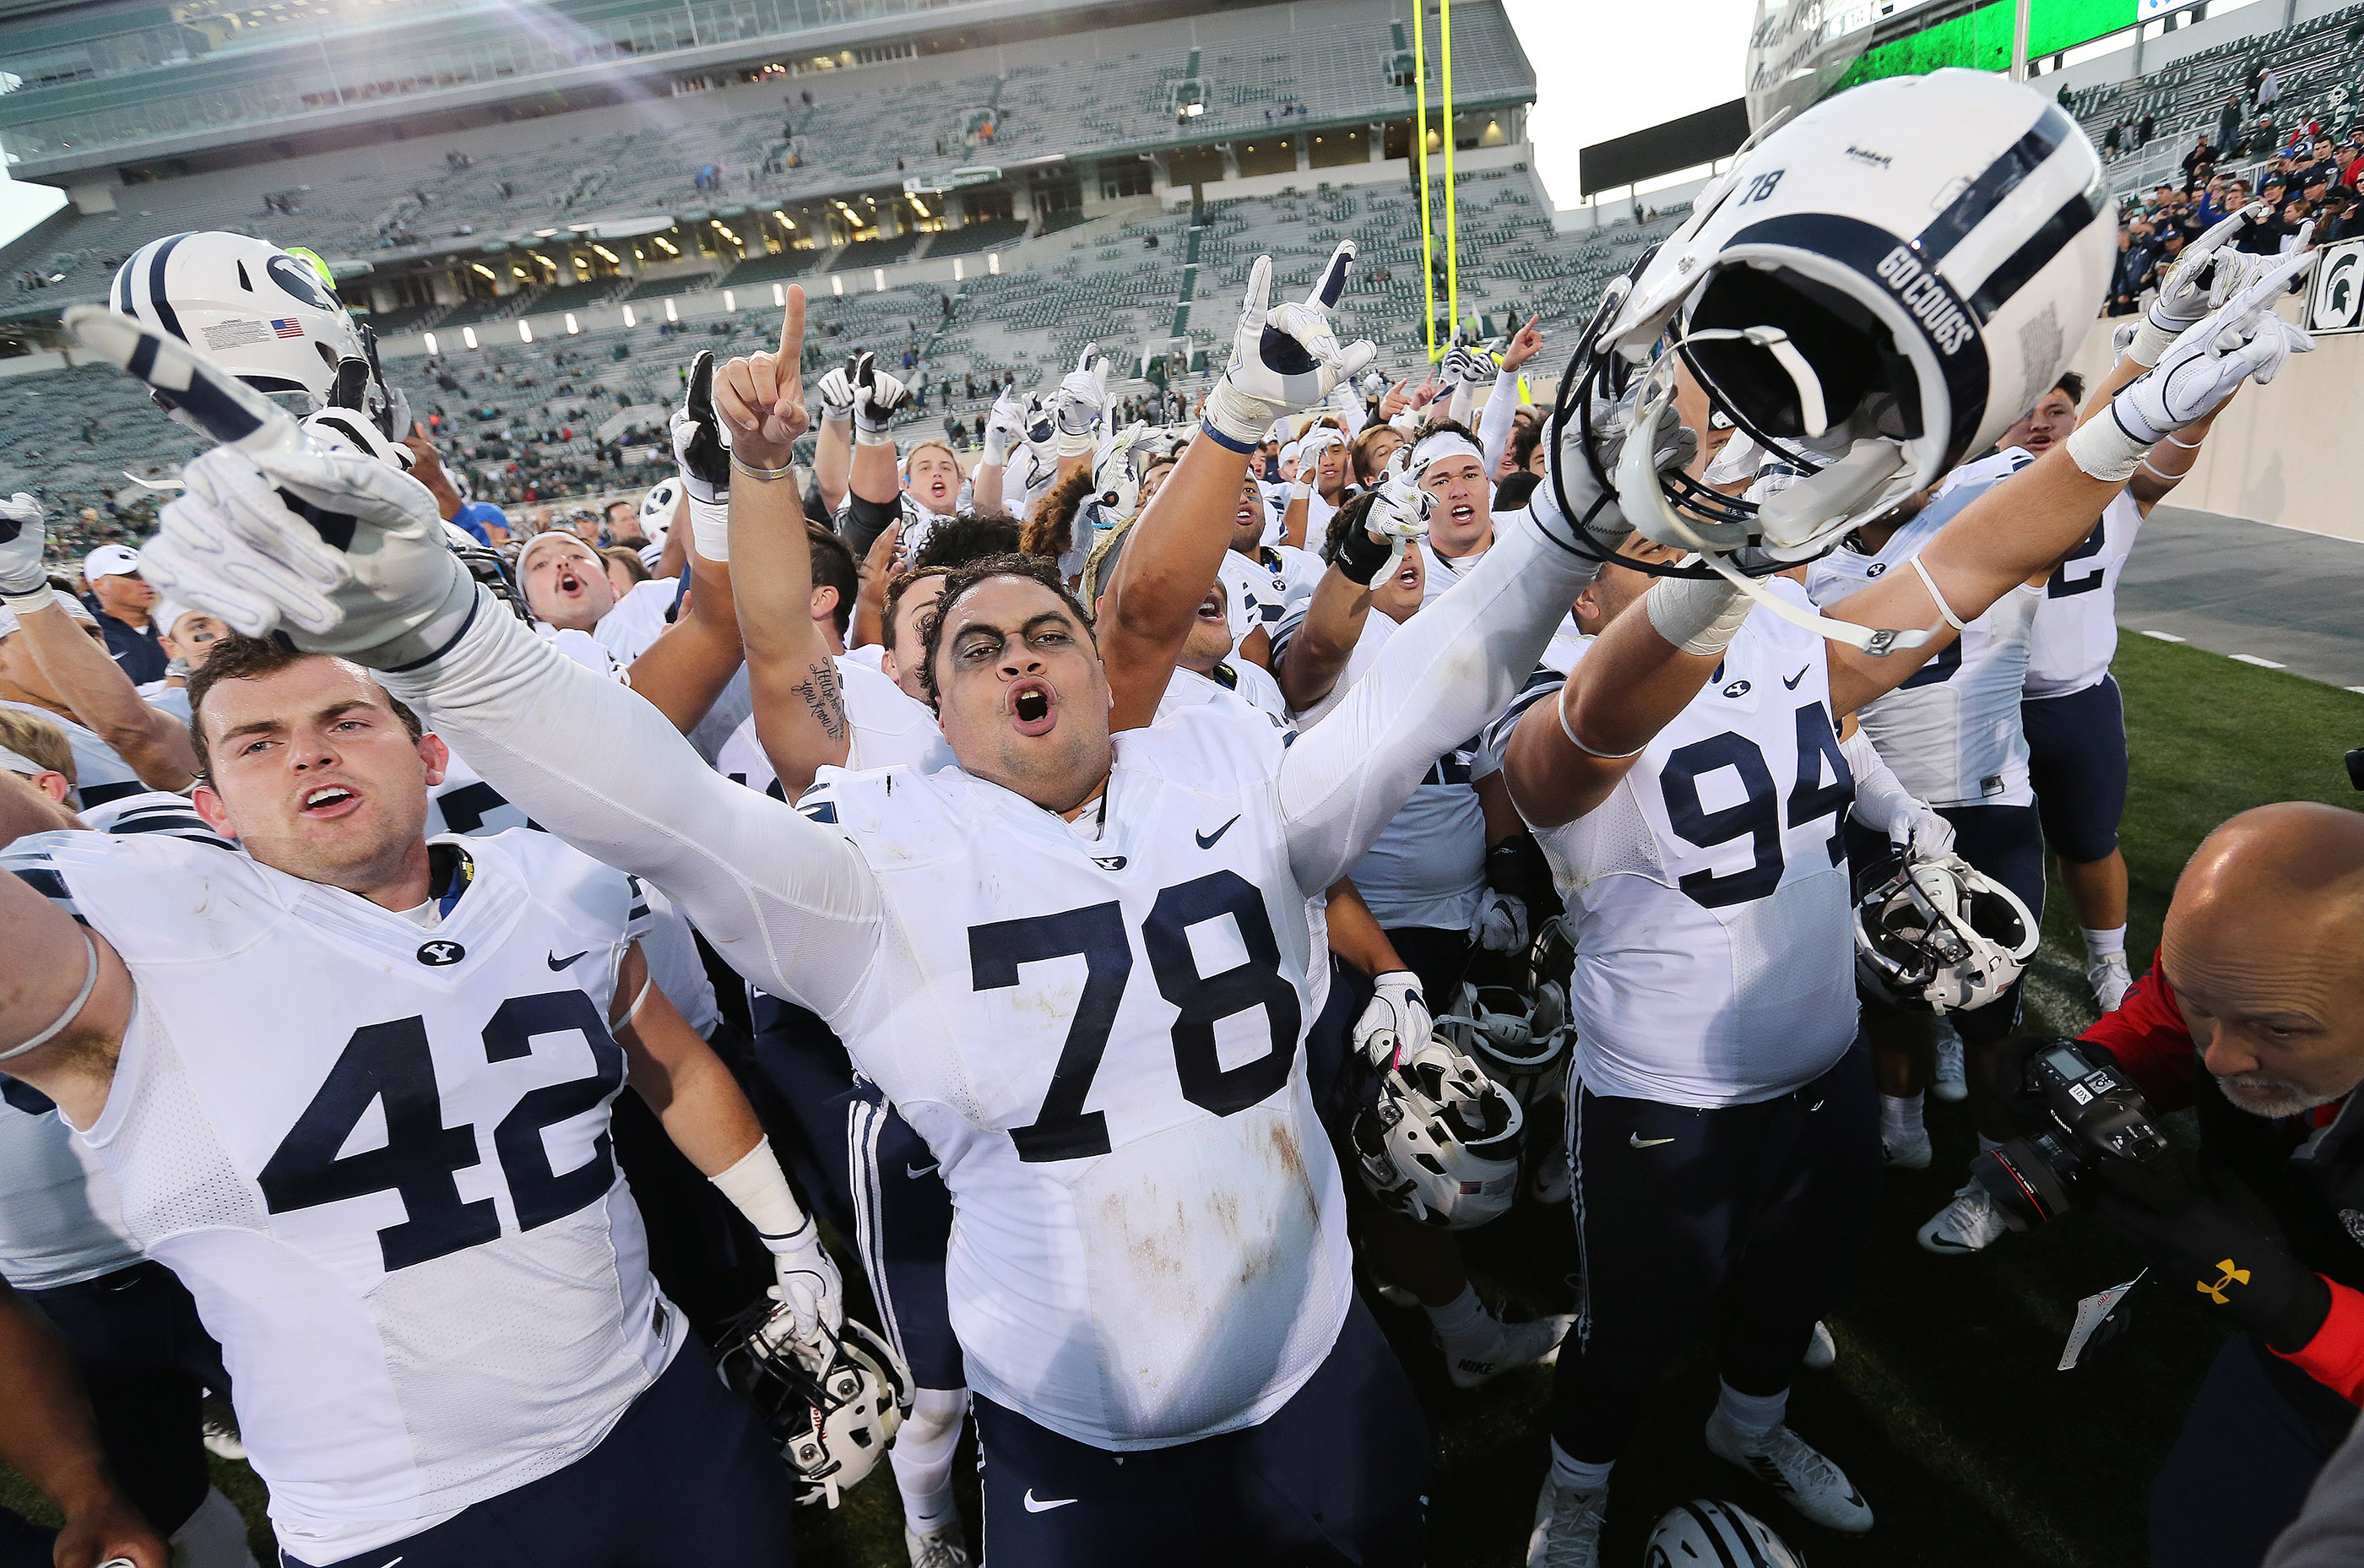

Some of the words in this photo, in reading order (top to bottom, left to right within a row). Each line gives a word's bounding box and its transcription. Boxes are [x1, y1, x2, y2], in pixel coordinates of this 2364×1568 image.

[1738, 168, 1787, 208] 78
[1876, 245, 1922, 290] GO
[1901, 272, 1975, 356] COUGS
[1659, 701, 1857, 909] 94
[967, 869, 1303, 1164] 78
[256, 989, 629, 1273] 42
[2050, 1109, 2073, 1134] Canon
[2072, 1087, 2090, 1103] 1DX
[1457, 1358, 1495, 1375] NIKE
